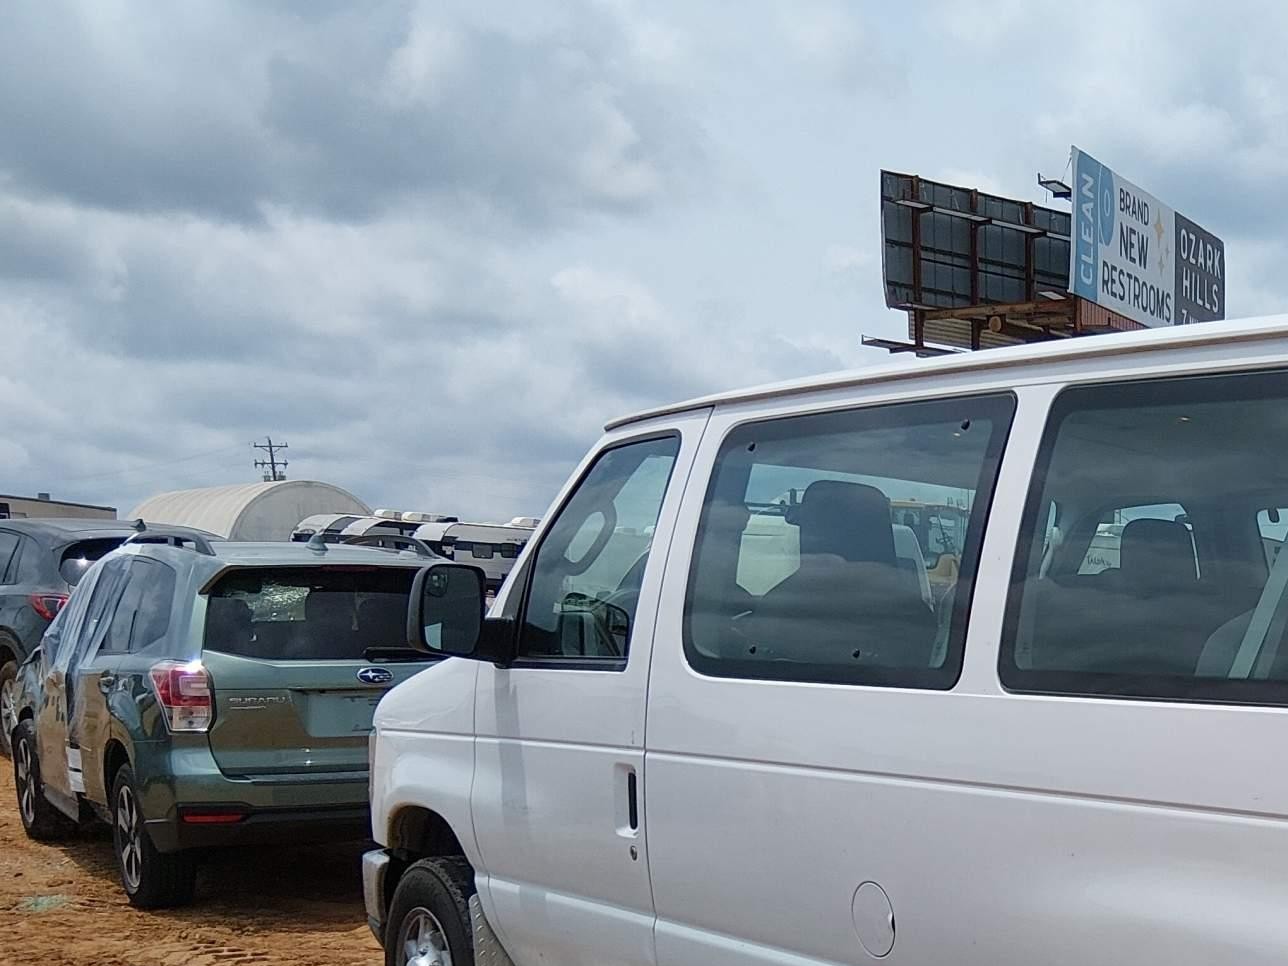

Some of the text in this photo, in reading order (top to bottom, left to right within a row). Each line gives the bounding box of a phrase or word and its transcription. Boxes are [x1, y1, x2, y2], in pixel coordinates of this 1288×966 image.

[1080, 172, 1096, 285] CLEAN
[1119, 187, 1149, 226] BRAND
[1119, 221, 1149, 270] NEW
[1180, 228, 1221, 279] OZARK
[1102, 260, 1172, 324] RESTROOMS
[1182, 267, 1219, 313] HILLS
